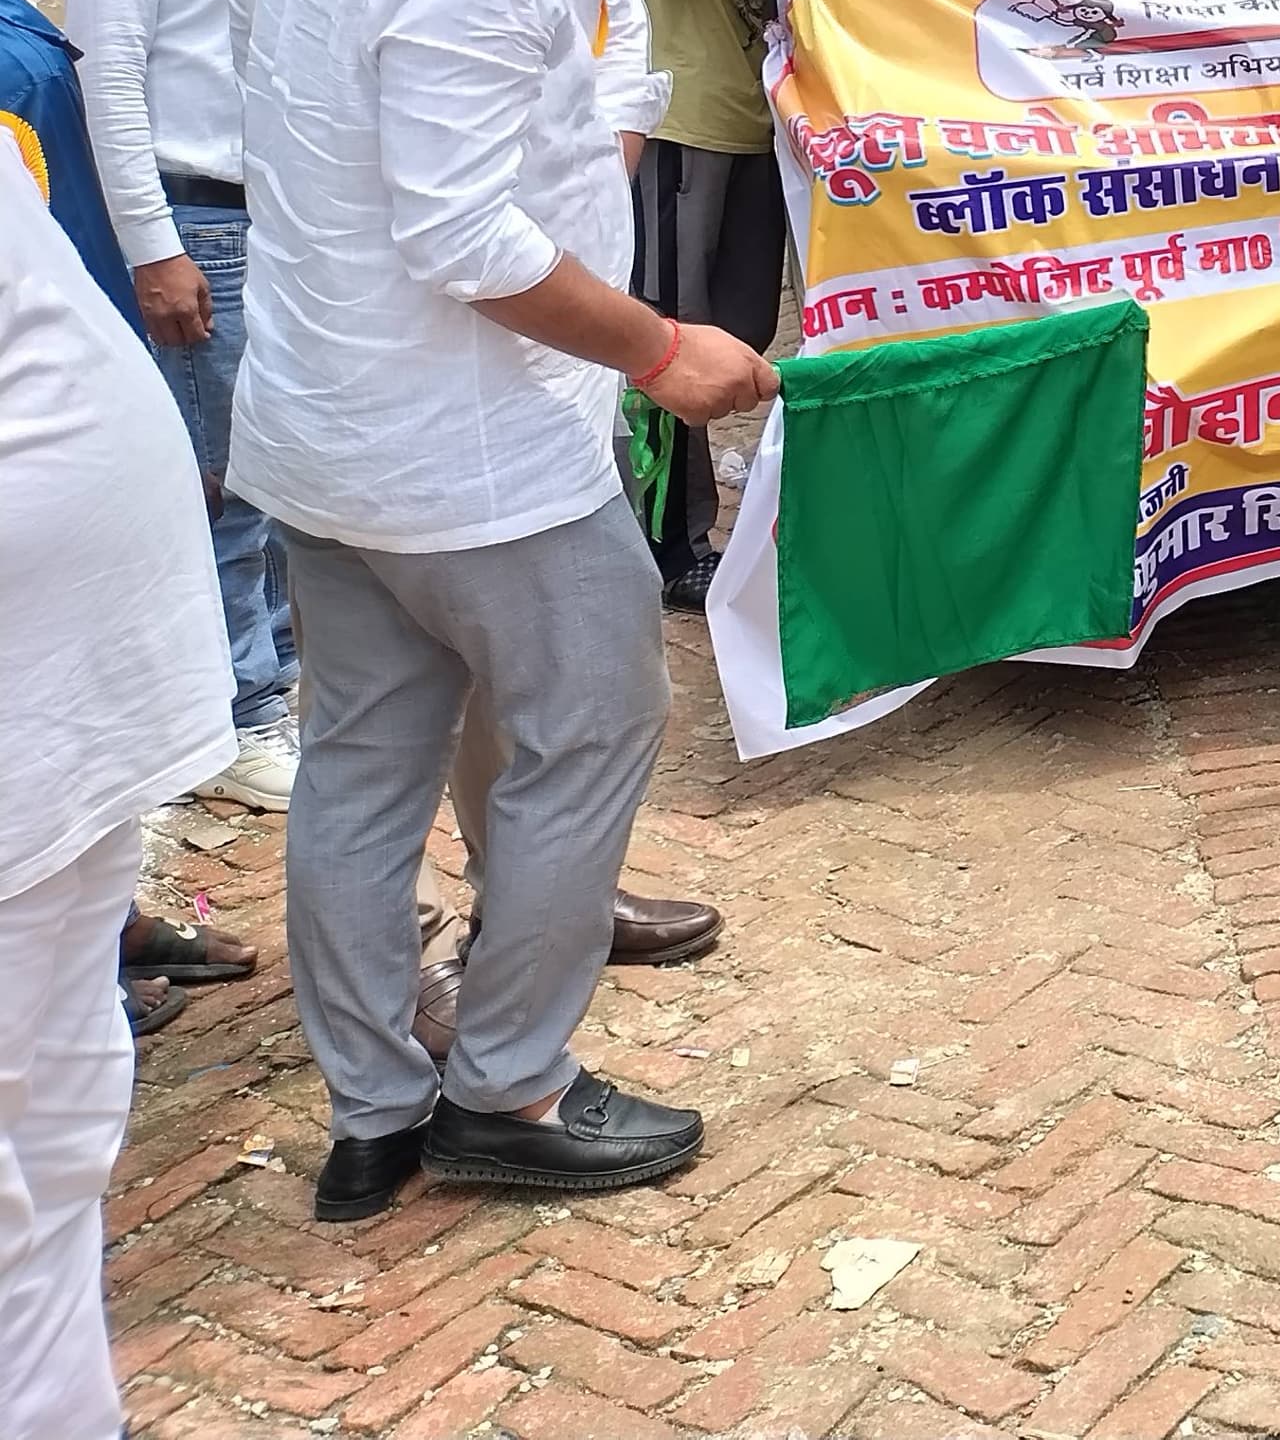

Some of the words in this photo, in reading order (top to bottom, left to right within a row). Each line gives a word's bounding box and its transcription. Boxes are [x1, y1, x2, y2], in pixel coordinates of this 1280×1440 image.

[1113, 62, 1192, 89] शिक्षा
[938, 106, 1078, 157] चलो
[909, 170, 1067, 235] ब्लॉक
[917, 255, 1114, 311] कम्पोजिट
[1122, 233, 1189, 303] पूर्व
